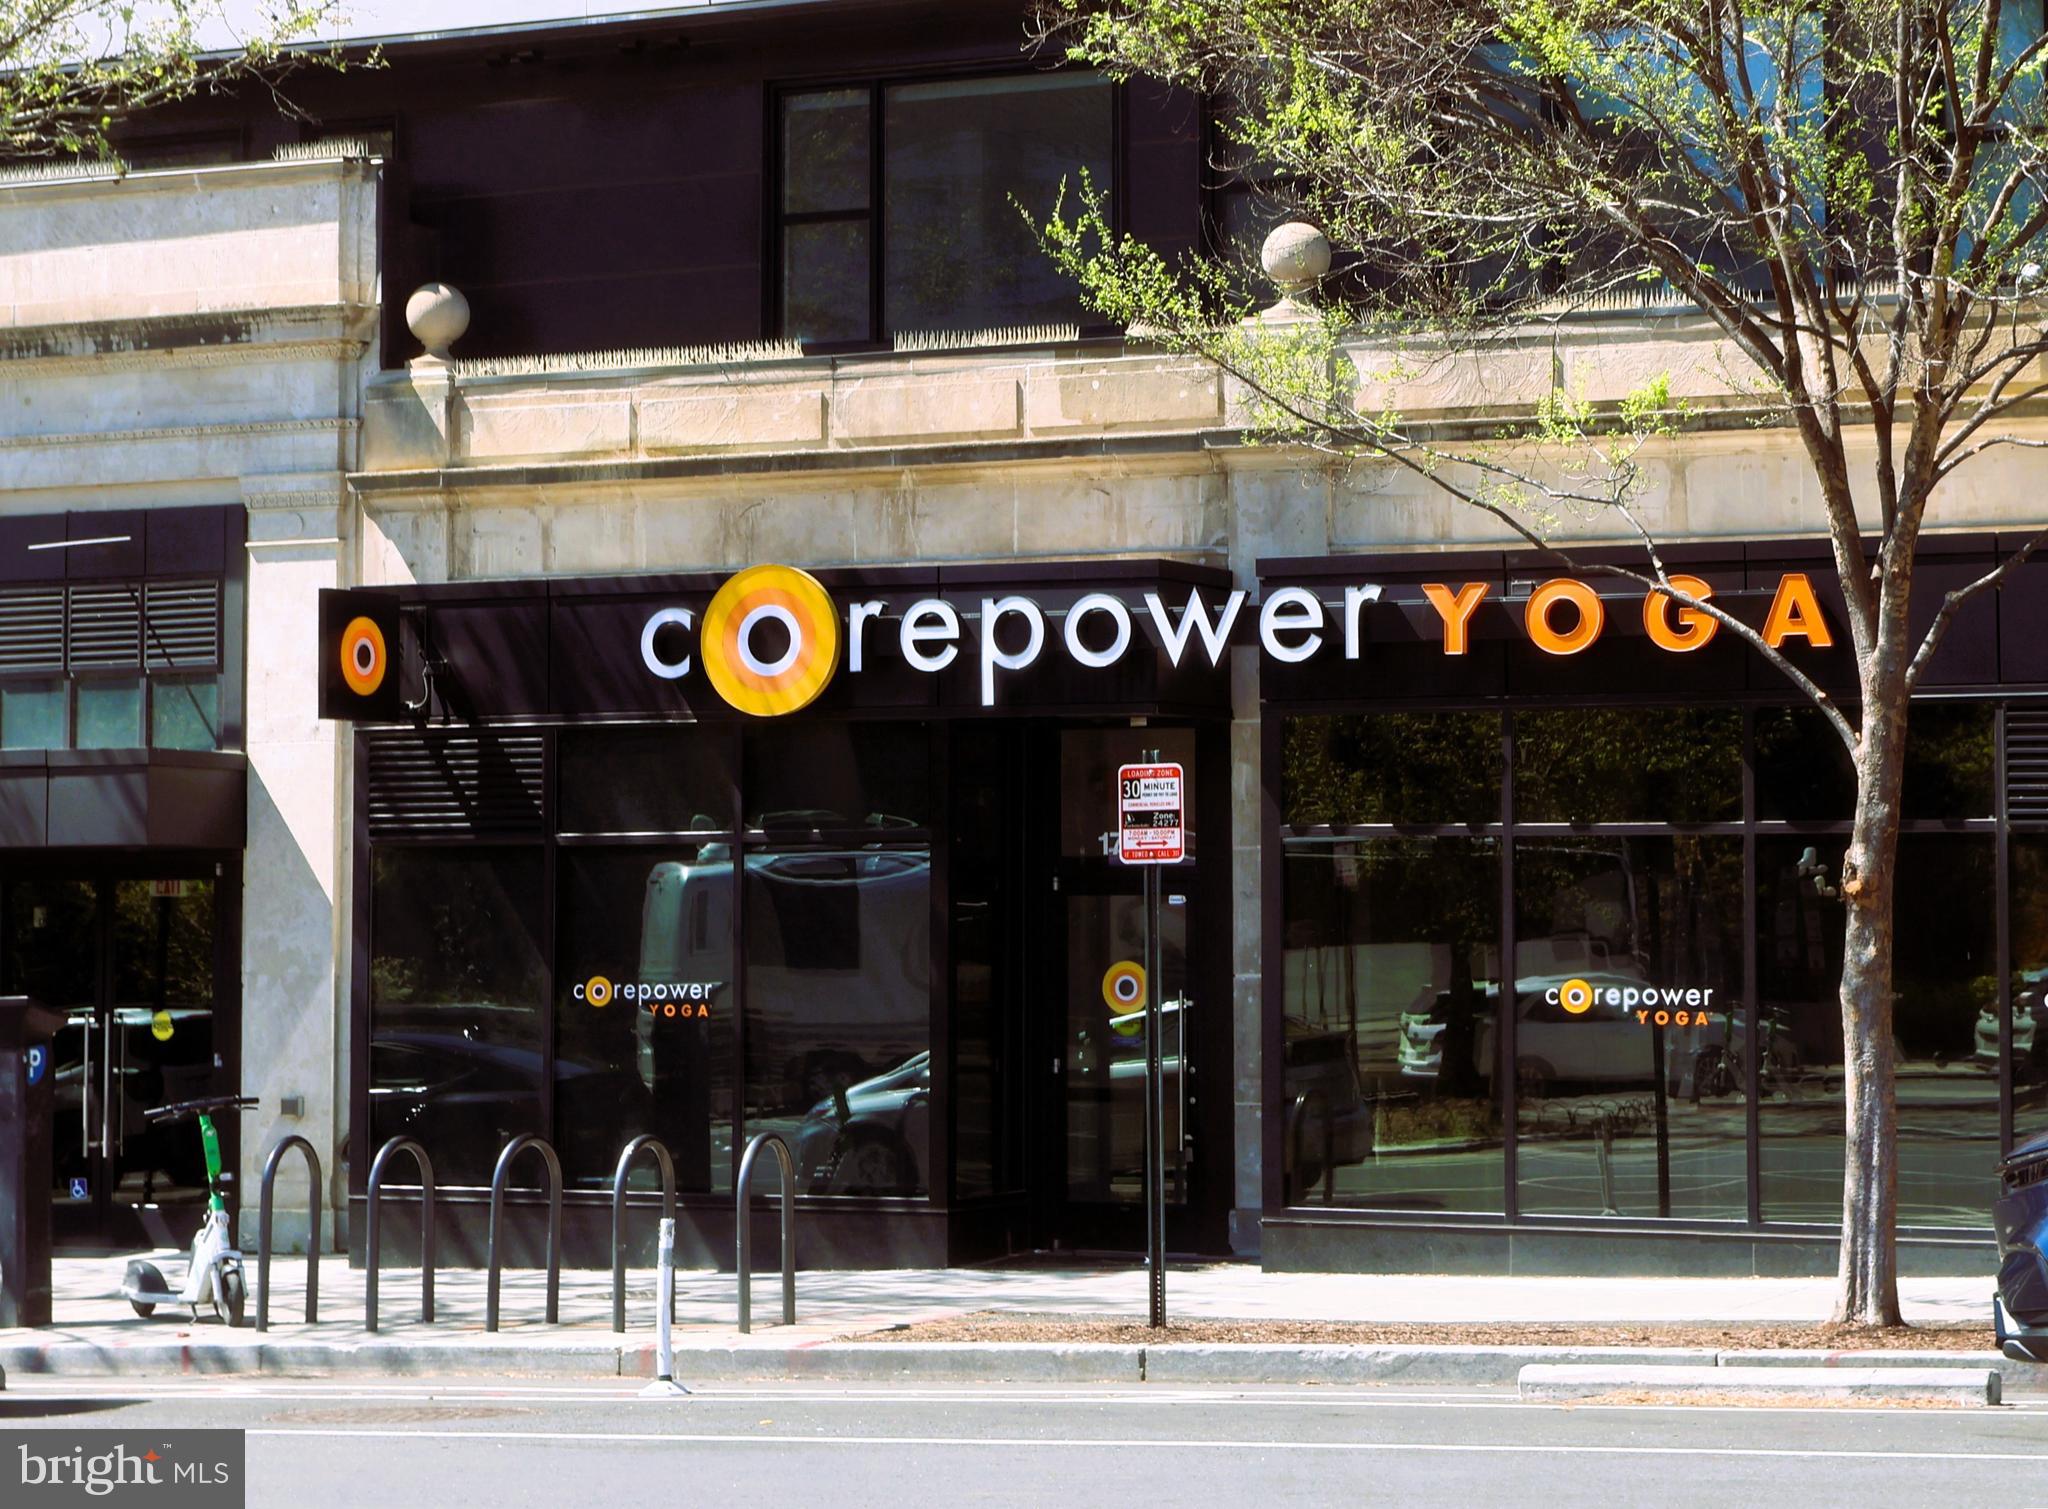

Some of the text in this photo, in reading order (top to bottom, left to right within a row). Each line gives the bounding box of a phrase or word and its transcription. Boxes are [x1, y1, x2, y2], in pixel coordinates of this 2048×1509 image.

[640, 566, 1833, 717] corepower YOGA
[1157, 768, 1173, 777] ZONE
[1123, 780, 1176, 798] 30 MINUTE
[1152, 819, 1179, 827] 24277
[1157, 849, 1170, 857] CALL
[573, 976, 713, 1007] corepower
[1545, 979, 1713, 1013] corepower
[649, 1003, 709, 1018] YOGA
[1636, 1010, 1709, 1026] YOGA
